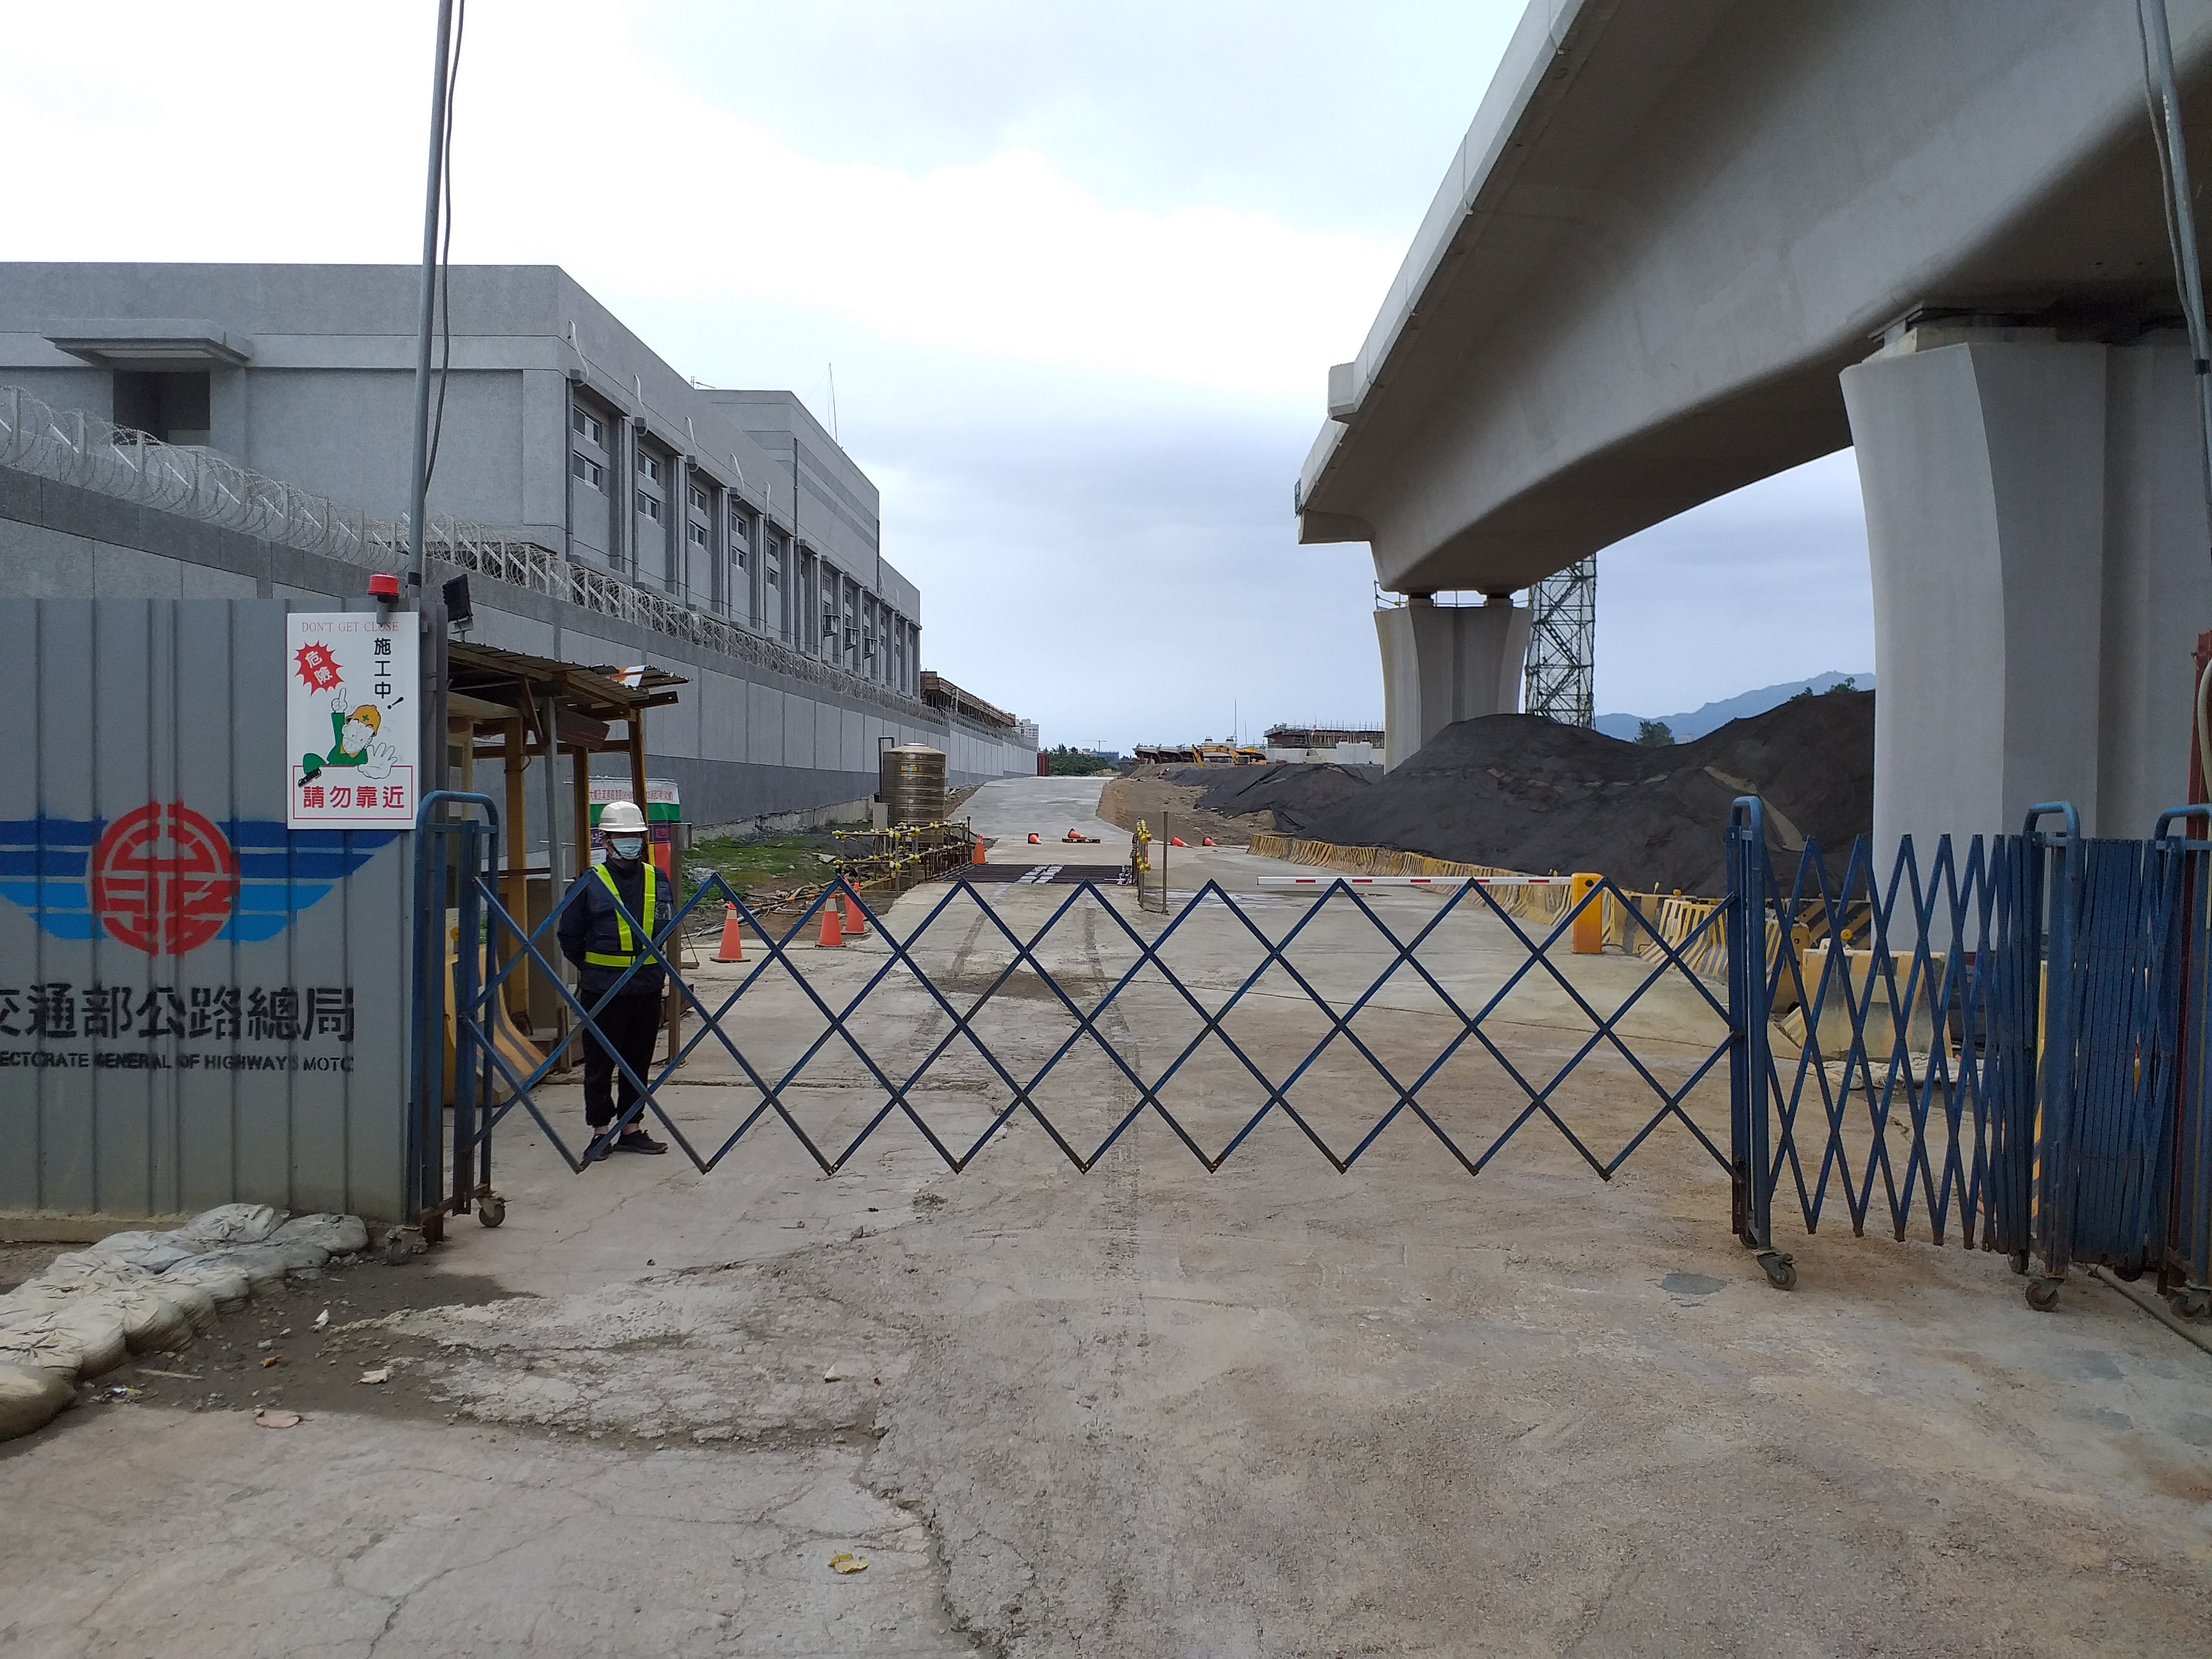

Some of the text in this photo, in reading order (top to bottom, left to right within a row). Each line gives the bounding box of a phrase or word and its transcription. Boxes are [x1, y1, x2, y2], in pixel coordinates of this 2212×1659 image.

[302, 622, 398, 632] DON'T GET CLOSE
[305, 651, 333, 685] 危險
[303, 786, 405, 809] 請勿靠近
